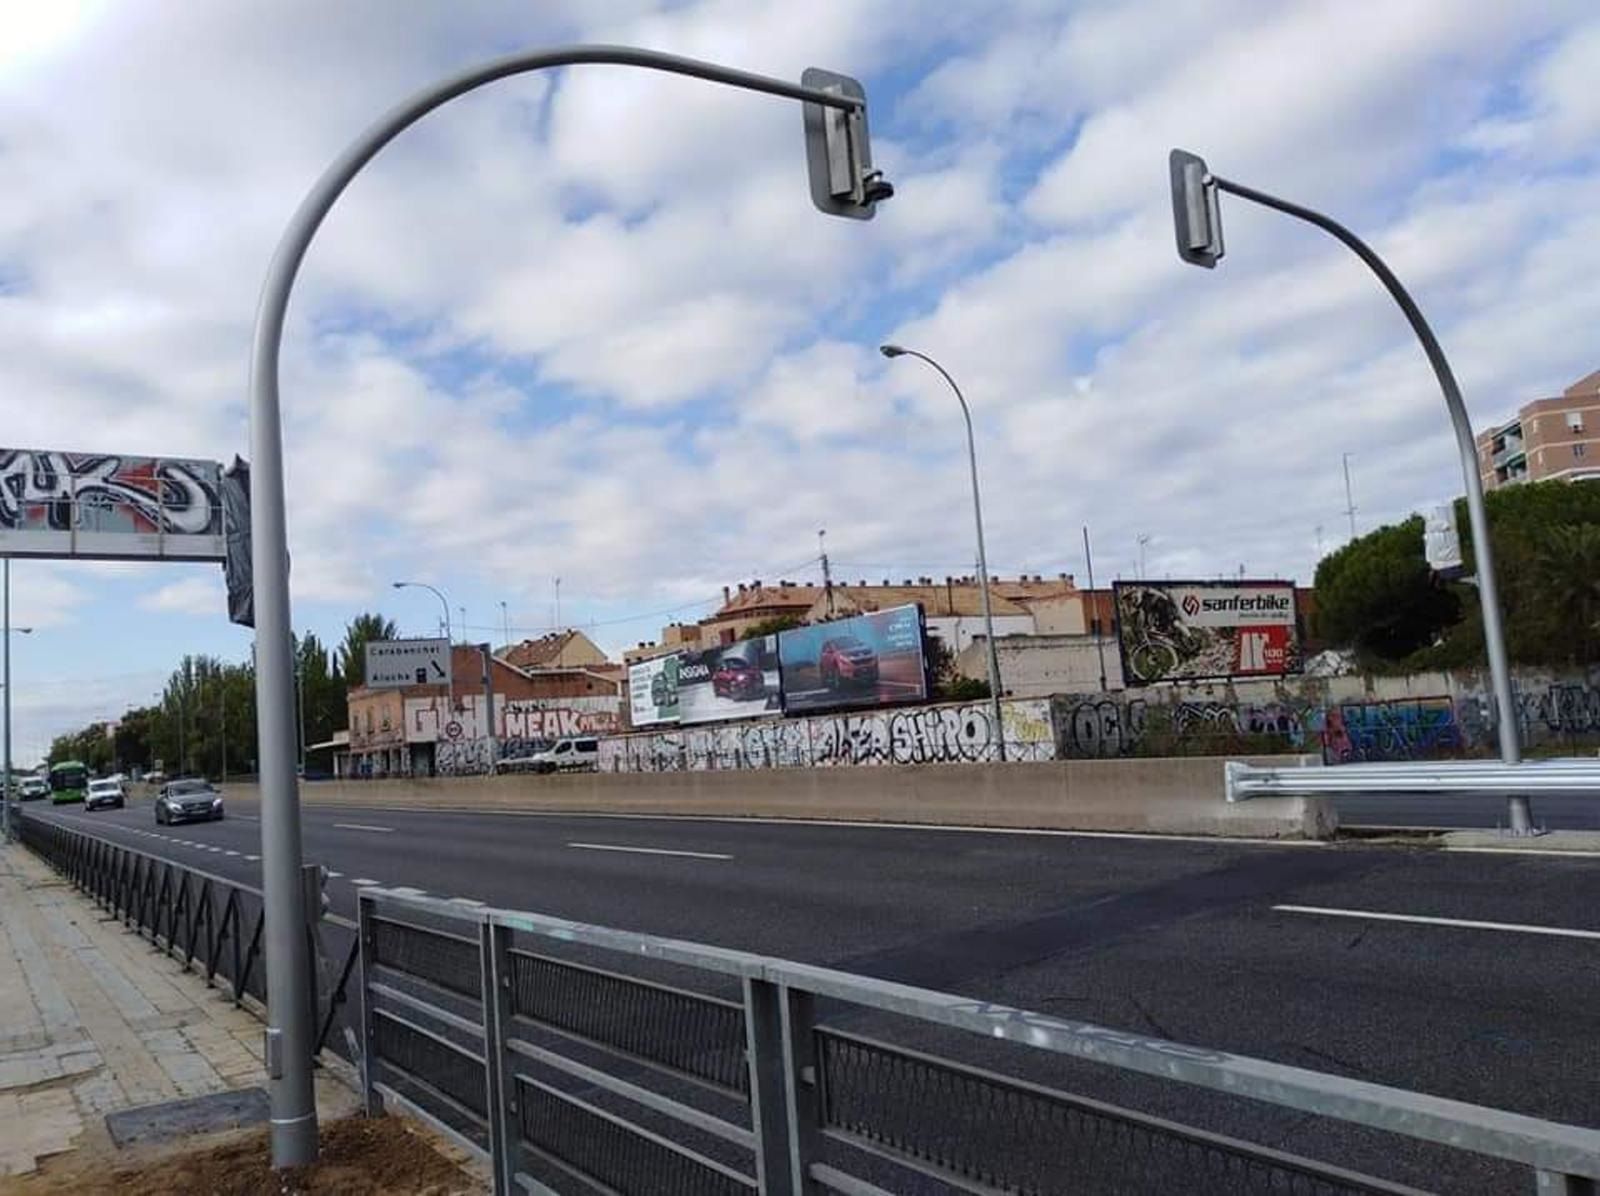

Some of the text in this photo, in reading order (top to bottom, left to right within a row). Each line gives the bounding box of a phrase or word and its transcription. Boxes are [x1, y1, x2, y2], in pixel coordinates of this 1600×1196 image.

[1202, 594, 1289, 612] sanferbike
[370, 645, 440, 656] Carabanchel
[372, 672, 410, 681] Aluche
[504, 708, 582, 738] MEAK
